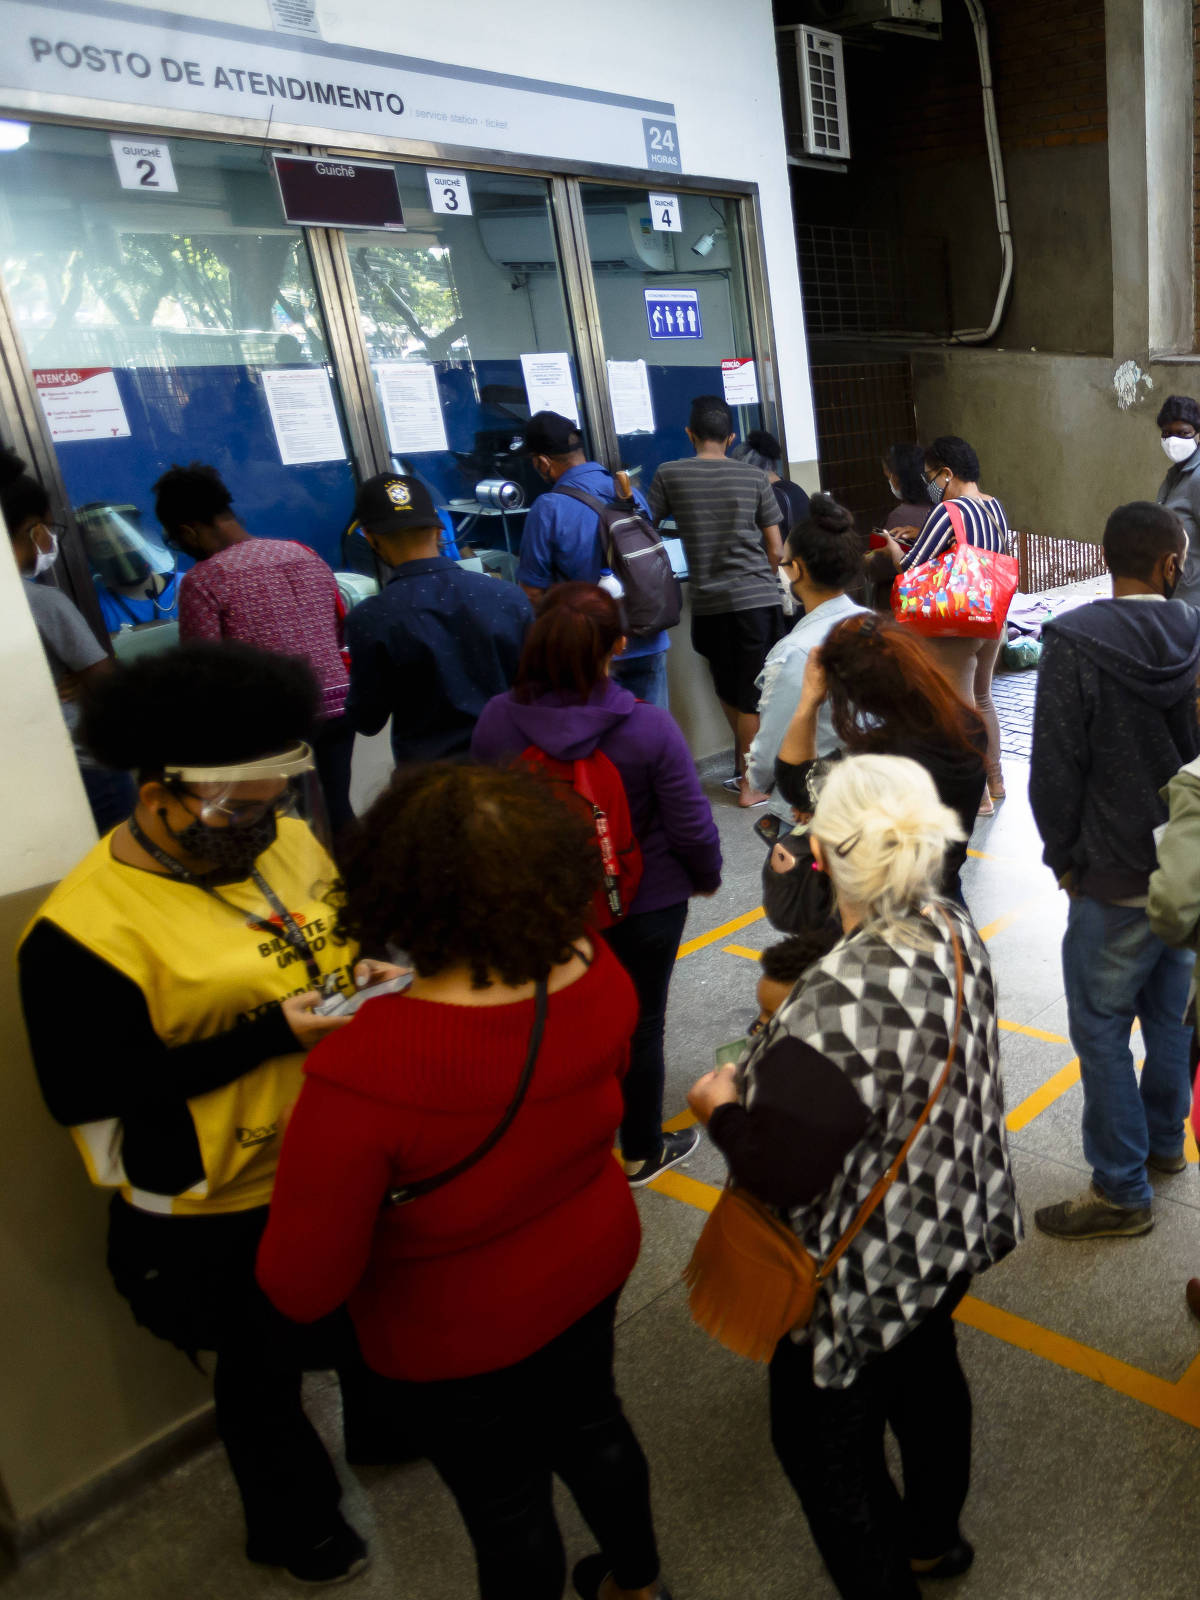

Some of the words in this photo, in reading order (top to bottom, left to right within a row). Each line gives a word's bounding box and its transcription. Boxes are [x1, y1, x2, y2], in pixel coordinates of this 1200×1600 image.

[29, 36, 151, 79] POSTO
[160, 57, 205, 87] DE
[213, 66, 405, 116] ATENDIMENTO
[415, 109, 448, 121] service
[649, 126, 675, 152] 24
[315, 162, 356, 178] Guichê
[651, 154, 678, 166] HORAS
[136, 159, 160, 187] 2
[443, 188, 459, 211] 3
[661, 209, 672, 228] 4
